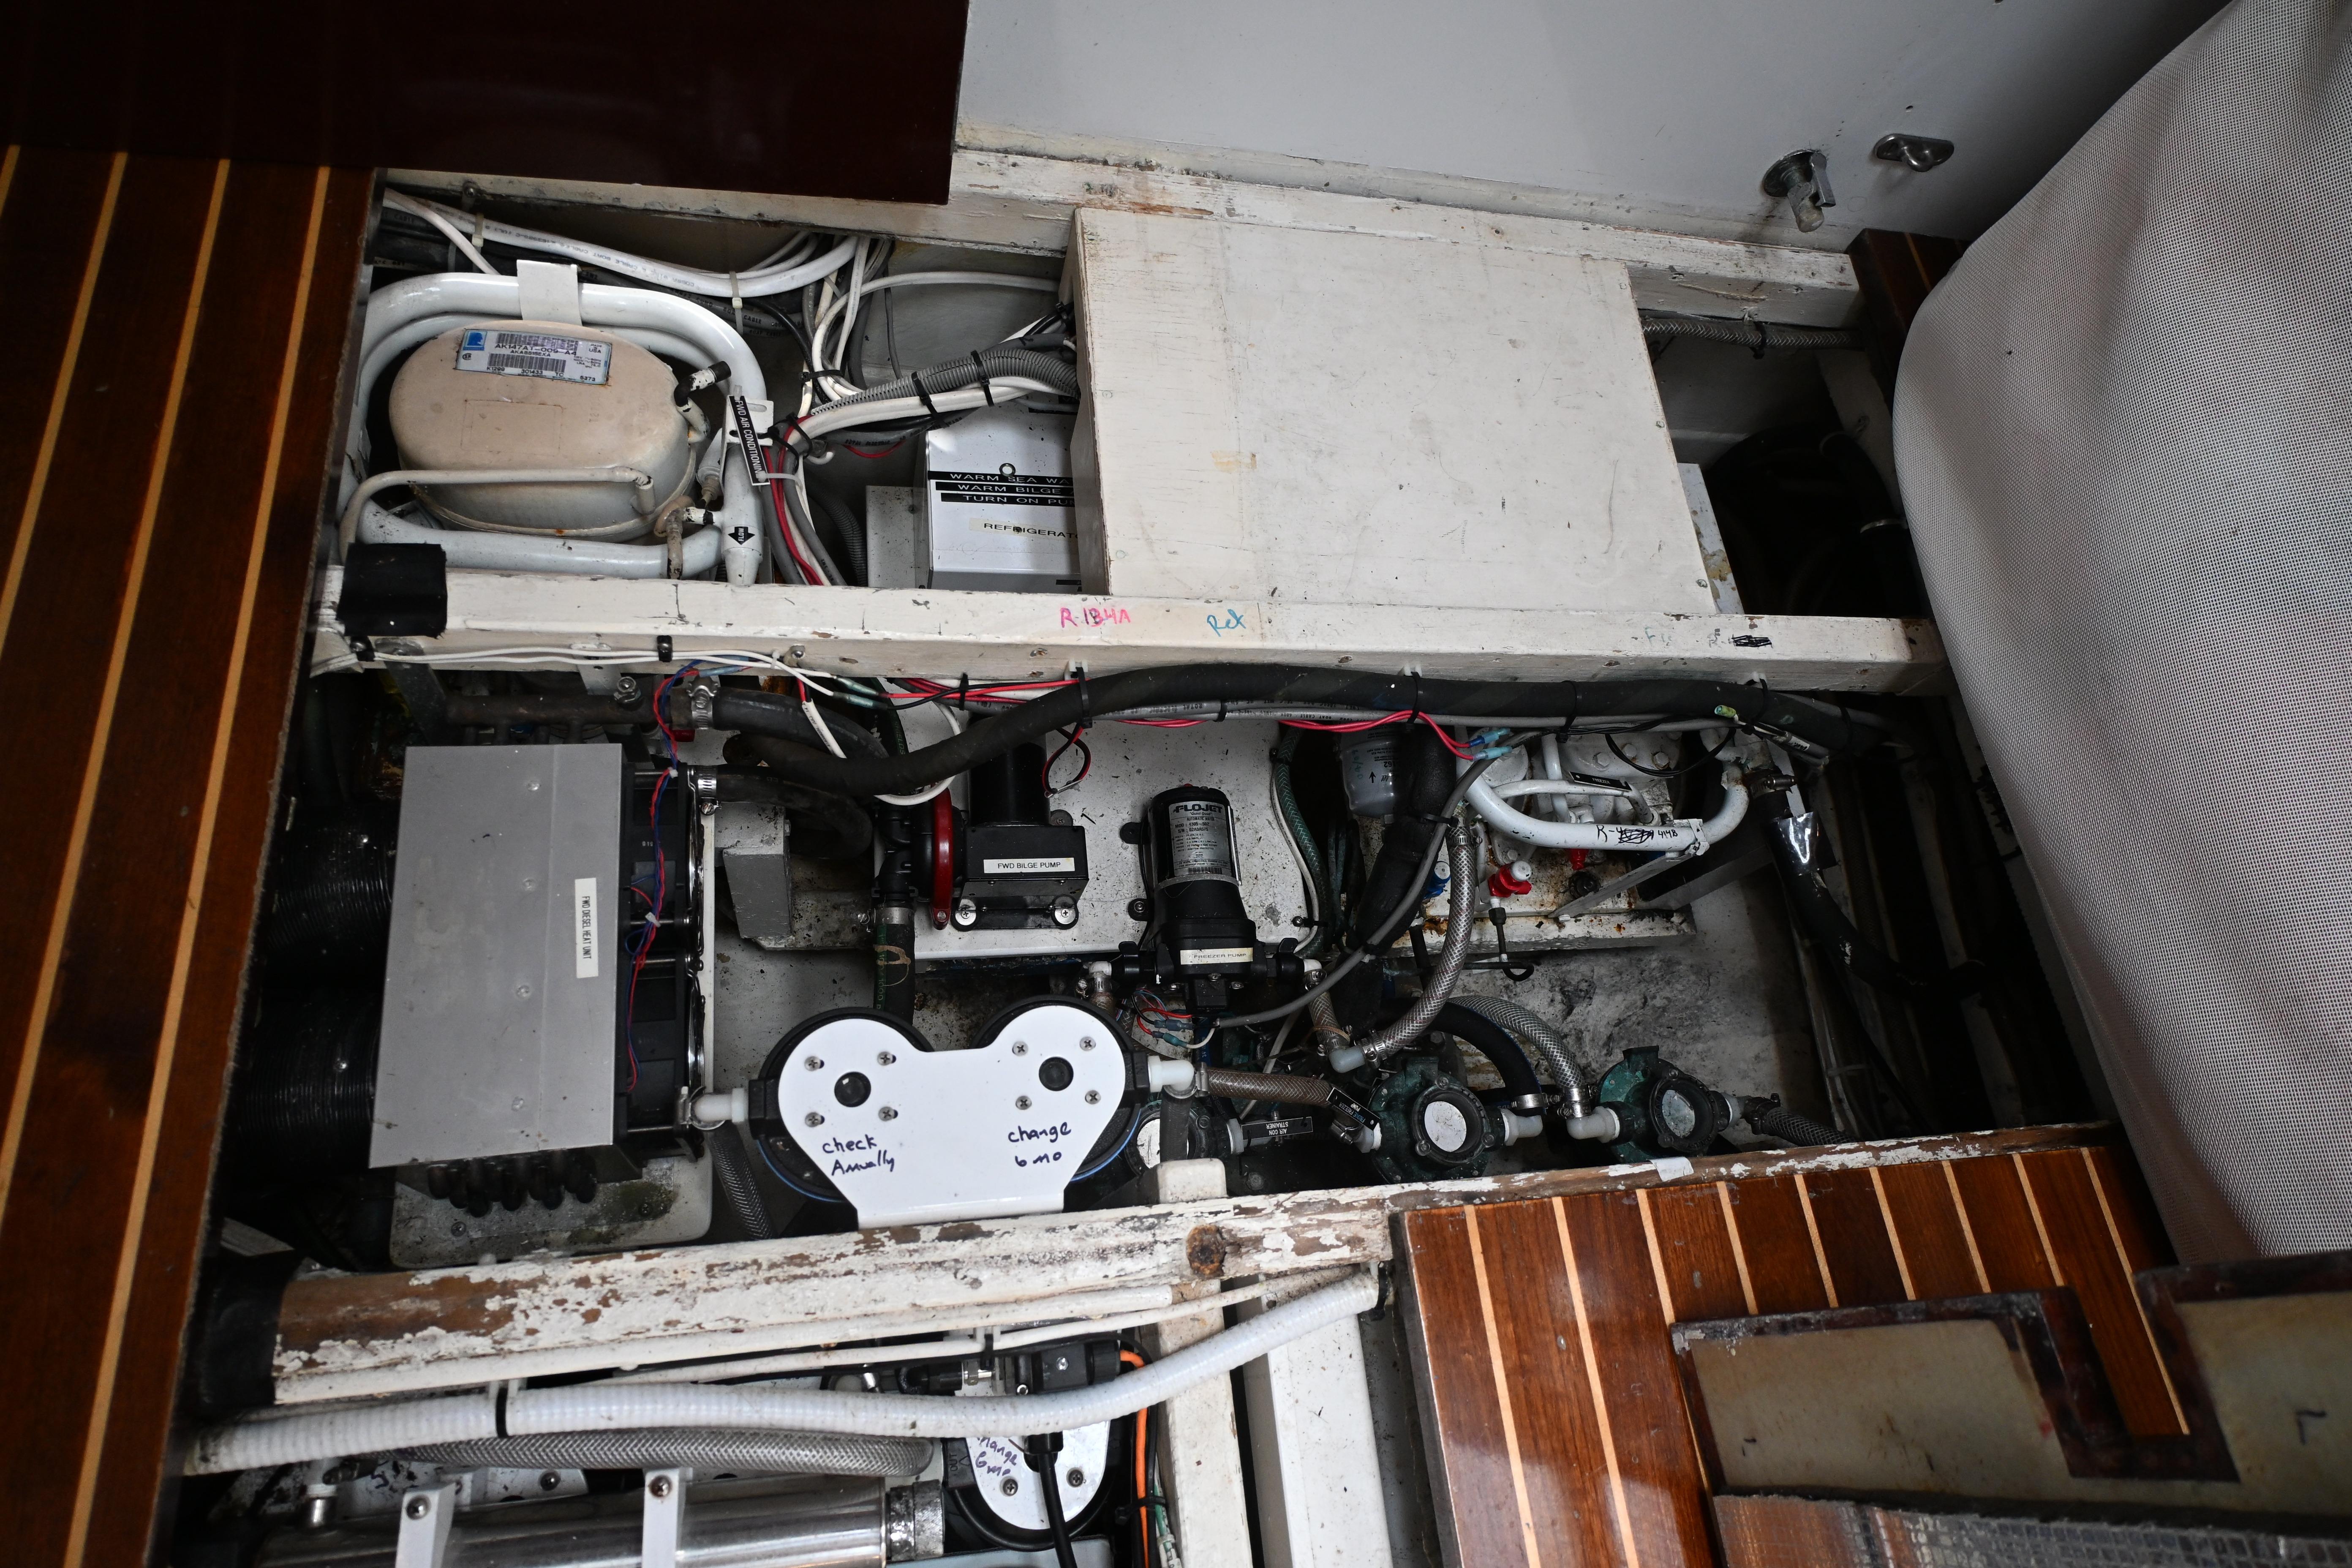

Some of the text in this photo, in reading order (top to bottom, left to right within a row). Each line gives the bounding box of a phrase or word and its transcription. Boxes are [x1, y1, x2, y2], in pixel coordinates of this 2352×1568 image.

[735, 400, 763, 474] FWD AIR CONDITIONIN
[984, 523, 1078, 539] REFRIGERAT
[1173, 804, 1222, 813] FLOJET
[582, 896, 591, 959] FWD DIESEL HEAT UNIT
[1338, 1102, 1354, 1115] FREEZER
[1350, 1103, 1361, 1112] PUMP
[1008, 1122, 1071, 1143] change
[822, 1133, 877, 1154] check
[950, 1453, 958, 1471] OUT
